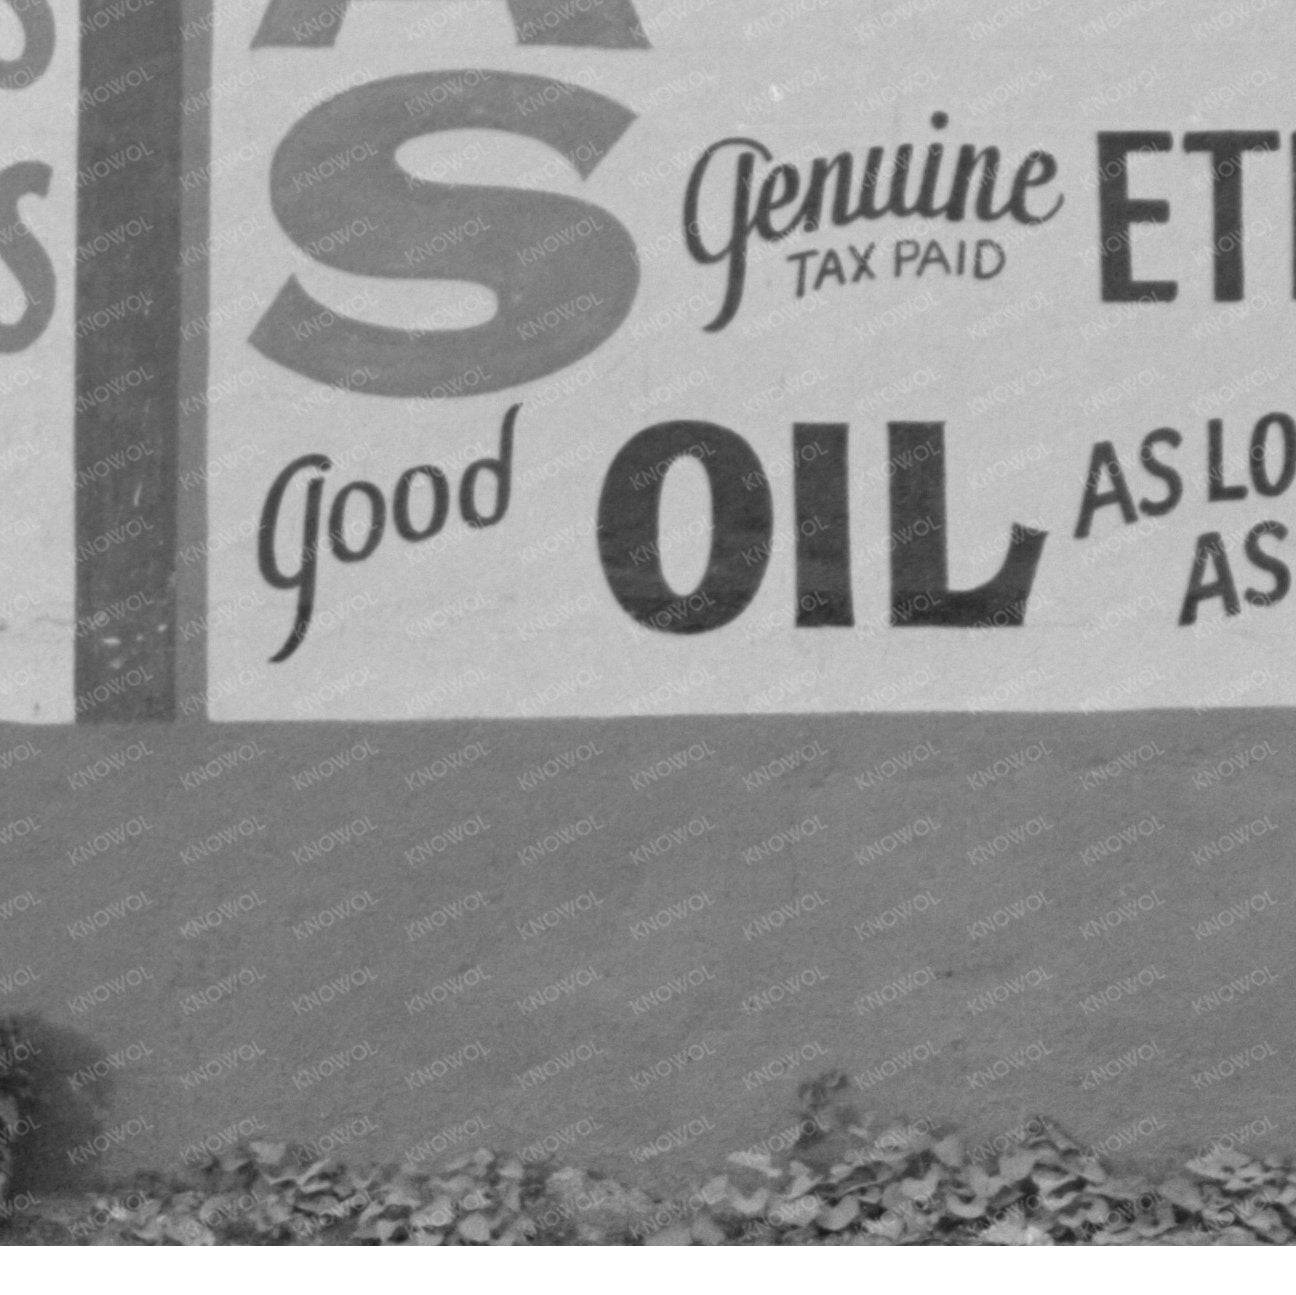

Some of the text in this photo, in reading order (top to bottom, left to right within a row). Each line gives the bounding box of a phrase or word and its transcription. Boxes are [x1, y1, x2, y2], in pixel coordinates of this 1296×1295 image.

[786, 237, 1006, 299] TAX PAID
[596, 418, 1049, 635] OIL
[1073, 426, 1184, 540] AS
[1178, 519, 1292, 627] AS
